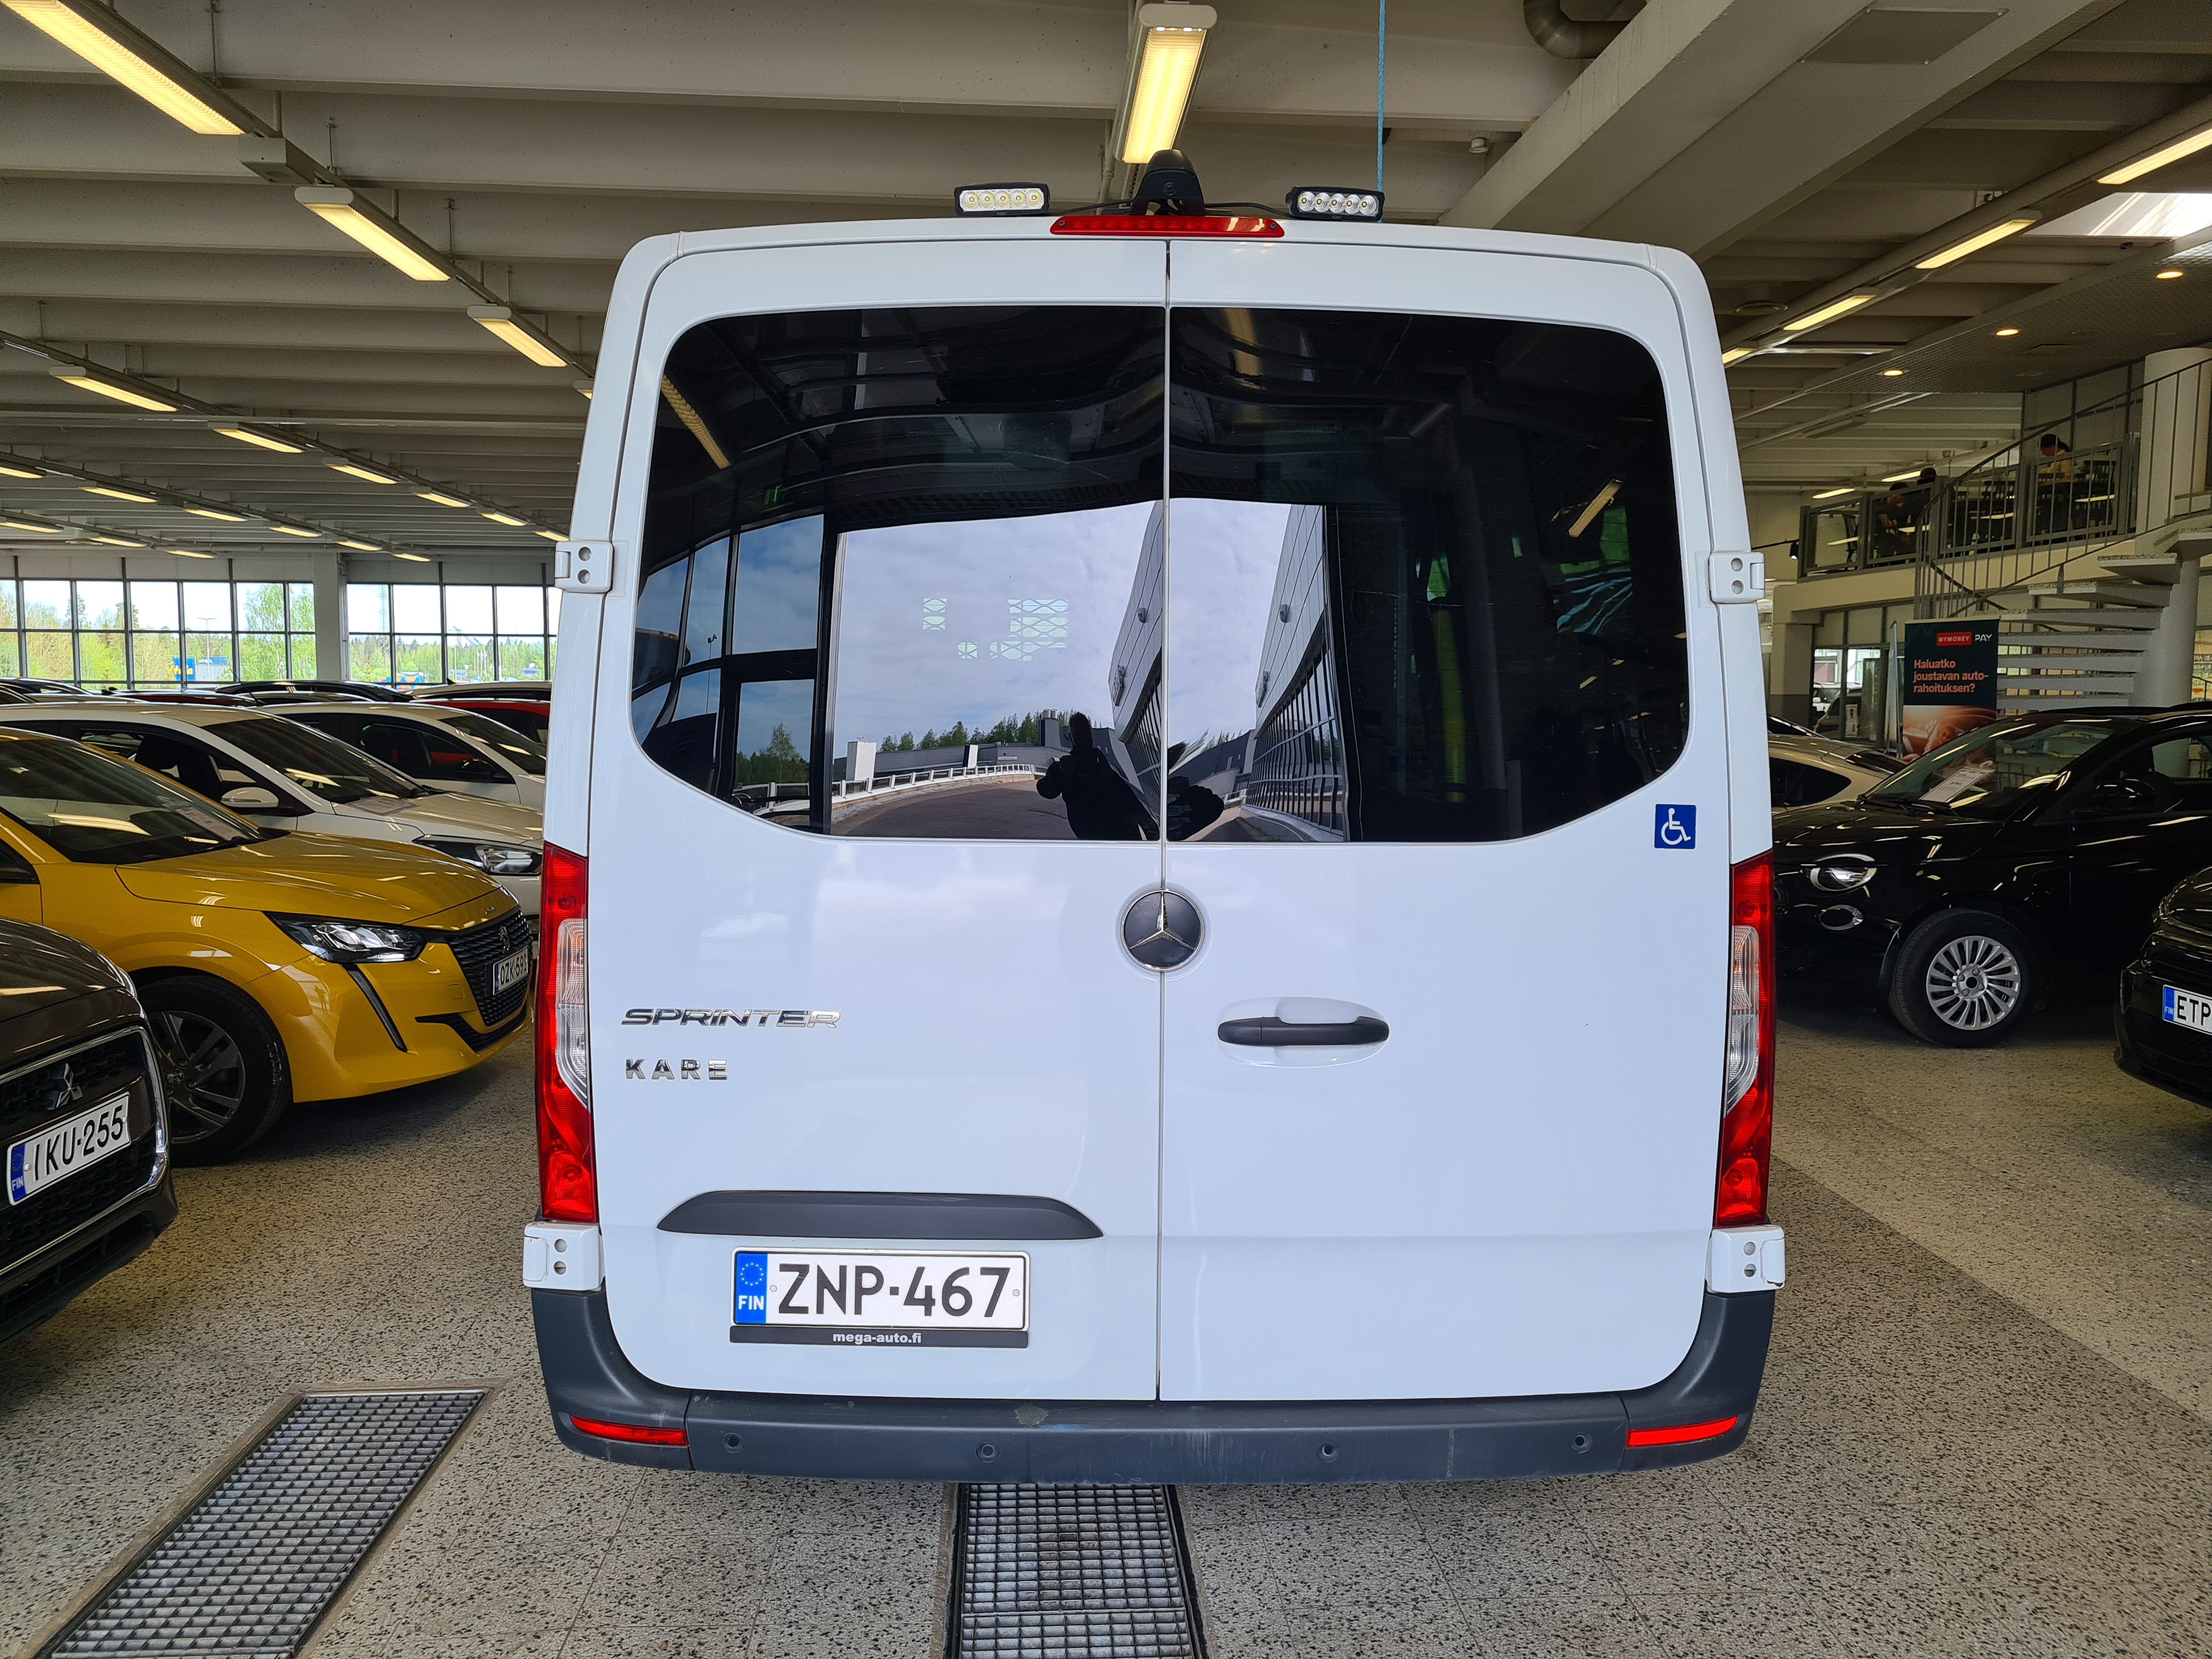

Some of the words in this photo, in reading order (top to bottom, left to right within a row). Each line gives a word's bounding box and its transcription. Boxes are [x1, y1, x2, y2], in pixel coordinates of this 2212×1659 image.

[1975, 634, 1992, 642] PAY
[1914, 659, 1956, 669] Haluatko
[1913, 672, 1960, 683] joustavan
[1962, 671, 1988, 681] auto-
[1914, 683, 1976, 693] rahoituksen?
[621, 1008, 841, 1029] SPRINTER
[2165, 1007, 2174, 1015] FIN
[2177, 995, 2211, 1026] ETP
[626, 1058, 728, 1080] KARE
[34, 1104, 123, 1181] IKU-255
[12, 1176, 24, 1192] FIN
[778, 1263, 1011, 1318] ZNP-467
[738, 1295, 764, 1311] FIN
[832, 1331, 922, 1345] mega-auto.fi
